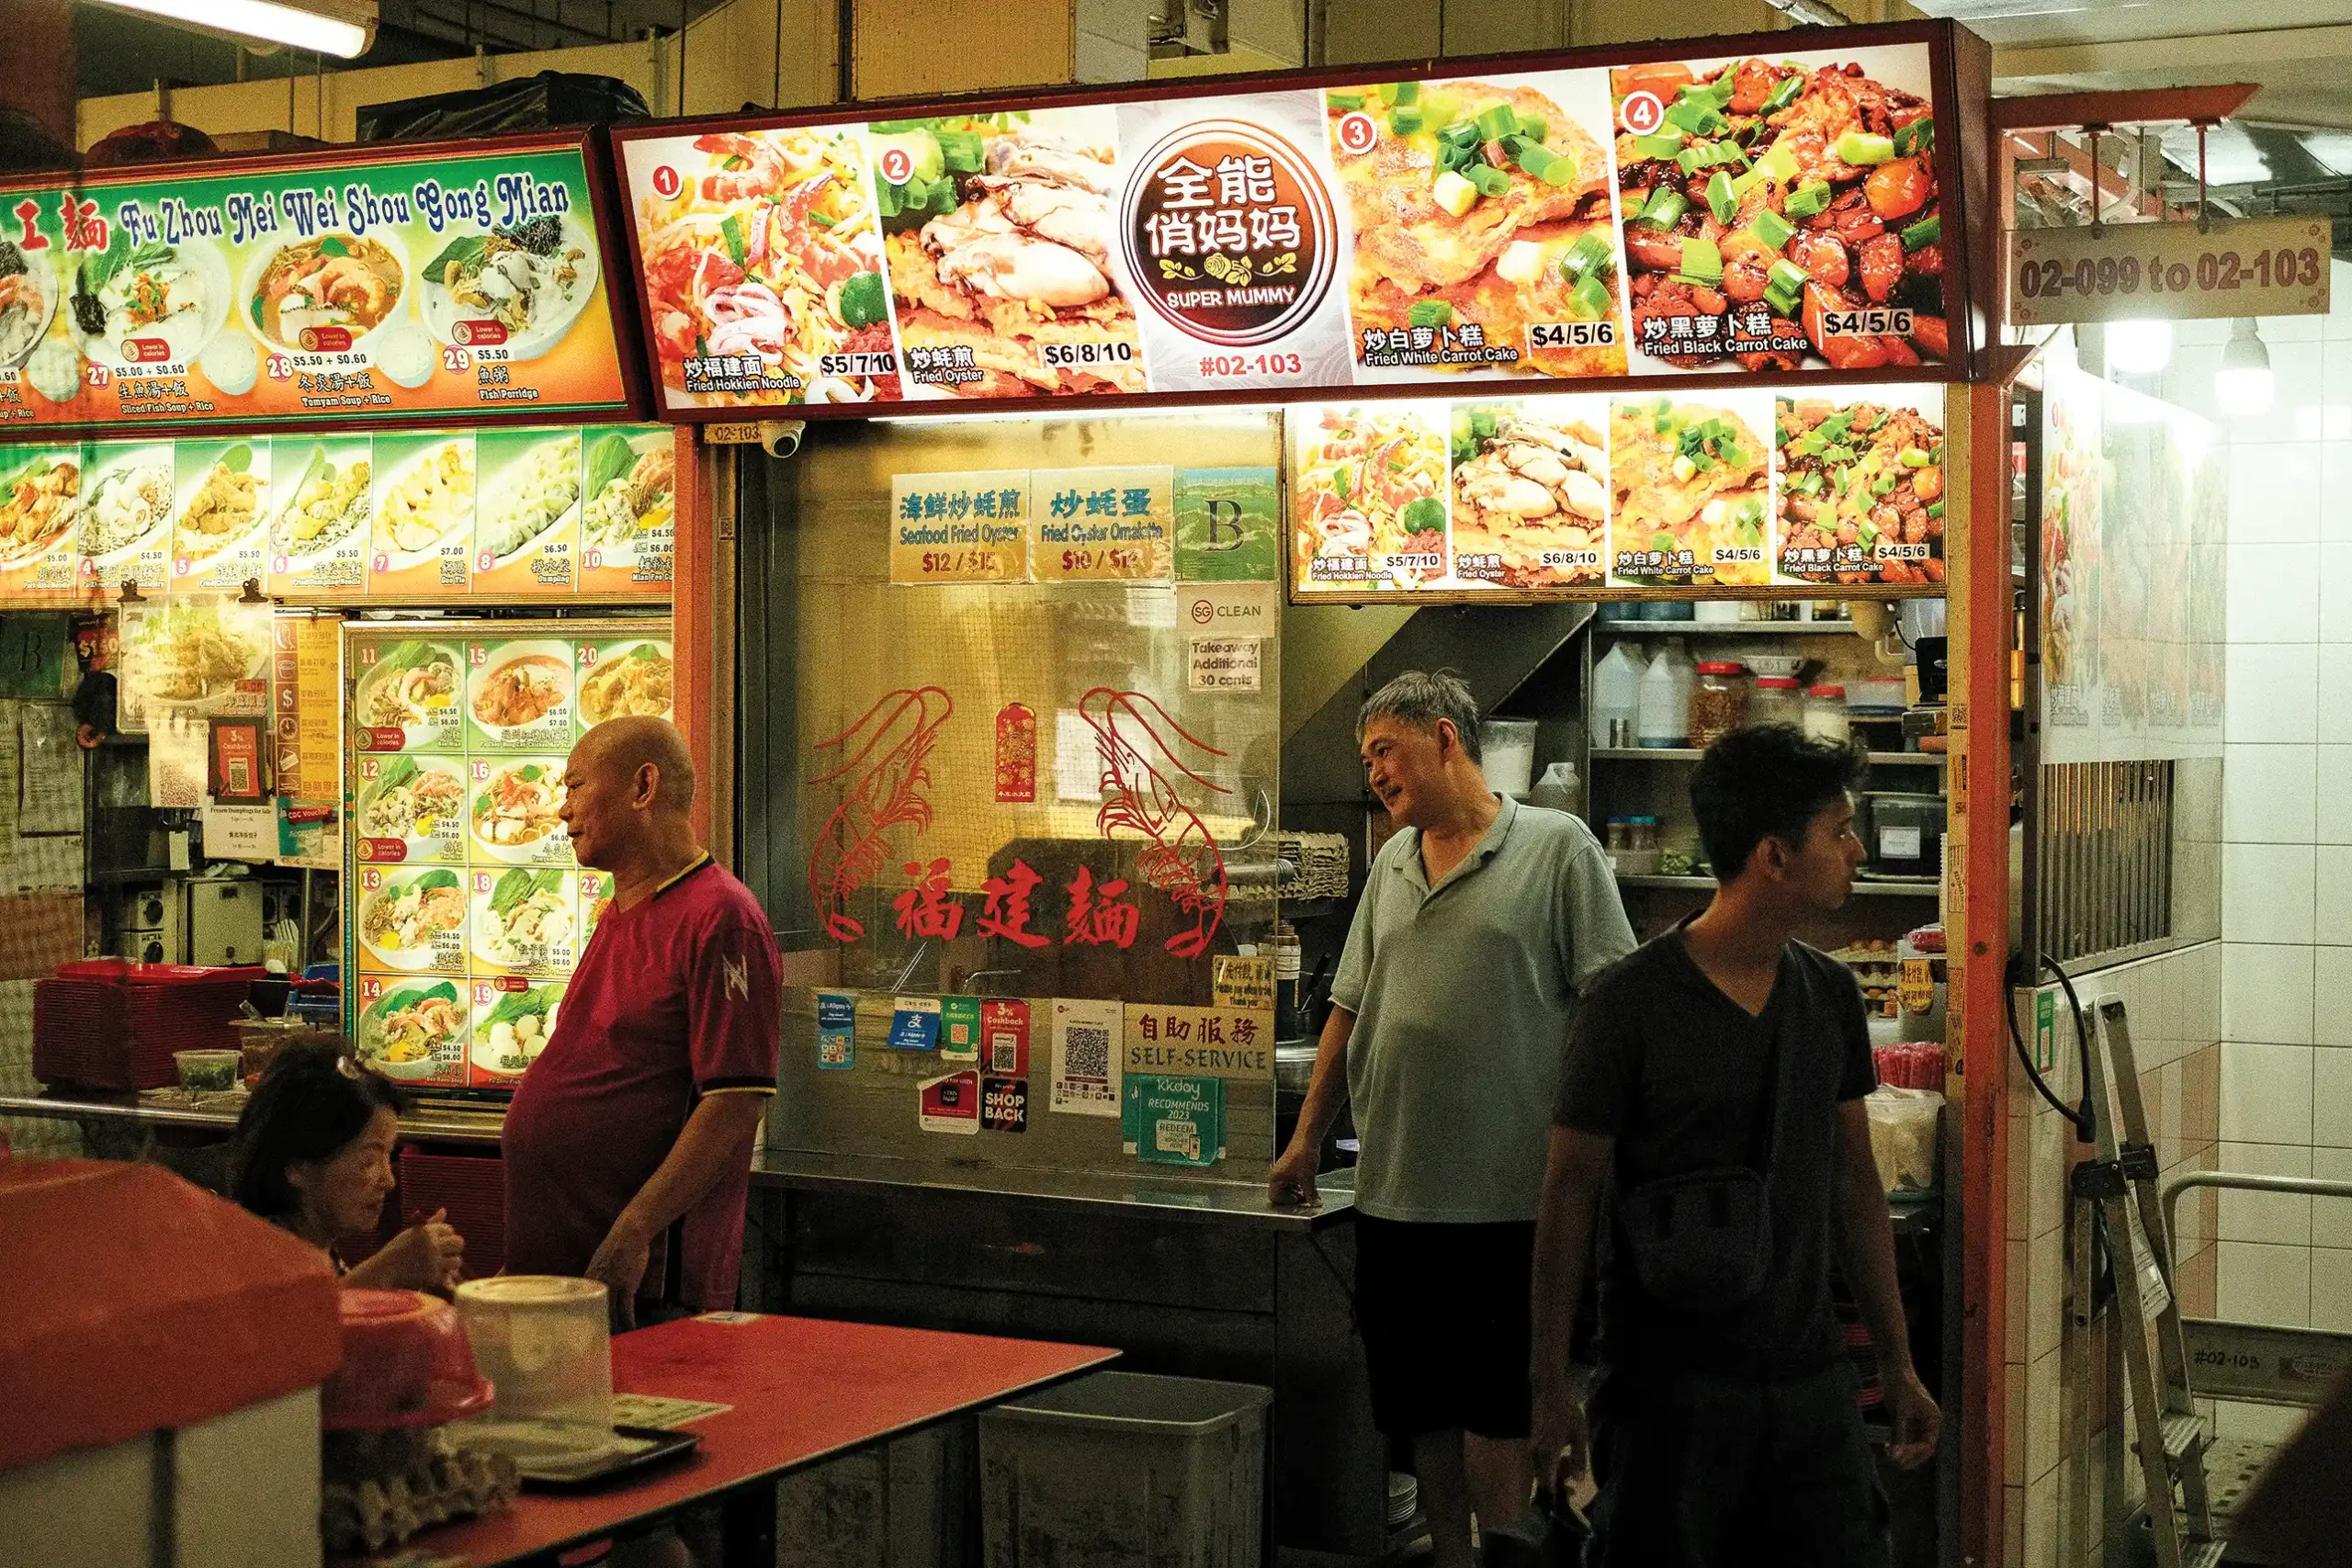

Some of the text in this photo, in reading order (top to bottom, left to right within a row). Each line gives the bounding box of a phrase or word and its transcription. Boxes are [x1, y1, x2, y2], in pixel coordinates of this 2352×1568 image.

[1633, 101, 1652, 126] 4
[1350, 120, 1364, 146] 3
[890, 153, 905, 177] 2
[660, 168, 673, 193] 1
[1157, 154, 1277, 210] 全能
[120, 175, 570, 246] Fu Zhou Mei Wei Shou Gong Mian
[1144, 205, 1302, 257] 俏妈妈
[2021, 247, 2321, 299] 02-099 to 02-103
[1167, 287, 1297, 310] SUPER MUMMY
[1642, 311, 1773, 340] 炒黑萝卜糕
[1824, 310, 1912, 334] $4/5/6
[1363, 323, 1484, 351] 炒白萝卜糕
[1532, 321, 1613, 347] $4/5/6
[478, 349, 509, 360] $5.50
[1045, 342, 1132, 366] $6/8/10
[1645, 336, 1808, 356] Fried Black Carrot Cake
[293, 353, 368, 367] $5.50 $0.60
[443, 348, 469, 370] 29
[821, 353, 895, 375] $5/7/10
[910, 345, 976, 369] 炒蚝煎
[1199, 353, 1302, 377] #02-103
[1364, 346, 1518, 367] Fried White Carrot Cake
[87, 362, 109, 386] 27
[116, 364, 185, 378] $5.00 $0.60
[266, 357, 294, 378] 28
[683, 355, 763, 378] 炒福建面
[686, 375, 800, 393] Fried Hokkien Noodle
[912, 367, 984, 384] Fried Oyster
[301, 394, 392, 408] Tomyam Soup Rice
[480, 387, 539, 400] Fish Porridge
[121, 400, 214, 414] Sliced Fish Soup Rice
[1050, 488, 1152, 519] 炒蚝蛋
[1041, 522, 1069, 543] Fried
[1204, 498, 1246, 552] B
[899, 521, 1020, 547] Seafood Fried Oyster
[441, 547, 464, 556] $7.00
[544, 544, 567, 554] $6.50
[1715, 547, 1761, 561] $4/5/6
[1878, 546, 1927, 559] $4/5/6
[582, 552, 602, 569] 10
[922, 551, 951, 573] $12
[1312, 556, 1368, 572] 炒福建面
[1386, 554, 1439, 569] $5/7/10
[1457, 553, 1501, 569] 炒蚝煎
[1543, 551, 1598, 565] $6/8/10
[1617, 549, 1694, 567] 炒白萝卜糕
[1457, 568, 1506, 580] Fried Oyster
[1618, 564, 1715, 576] Fried White Carrot Cake
[1784, 561, 1884, 573] Fried Black Carrot Cake
[537, 574, 570, 585] Dumpling
[1312, 570, 1393, 582] Fried Hokkien Noodle
[1194, 604, 1261, 618] SG CLEAN
[361, 648, 377, 663] 11
[469, 646, 487, 663] 15
[577, 646, 598, 664] 20
[1193, 642, 1259, 655] Takeaway
[1193, 657, 1259, 671] Additional
[1198, 674, 1252, 687] 30 cents
[362, 761, 379, 778] 12
[470, 761, 489, 778] 16
[288, 809, 301, 819] CDC
[362, 872, 380, 887] 13
[472, 874, 491, 890] 18
[582, 878, 601, 894] 22
[892, 857, 1140, 950] 福建麵
[552, 948, 571, 956] $5.00
[363, 981, 381, 998] 14
[474, 987, 492, 1002] 19
[997, 1002, 1014, 1017] 3%
[1138, 1011, 1260, 1046] 自助服務
[1130, 1046, 1267, 1071] SELF-SERVICE
[1157, 1077, 1201, 1100] kkday
[985, 1092, 1025, 1108] SHOP
[1148, 1098, 1210, 1111] RECOMMENDS
[985, 1106, 1024, 1122] BACK
[1167, 1109, 1190, 1120] 2023
[1159, 1122, 1194, 1134] REDEEM
